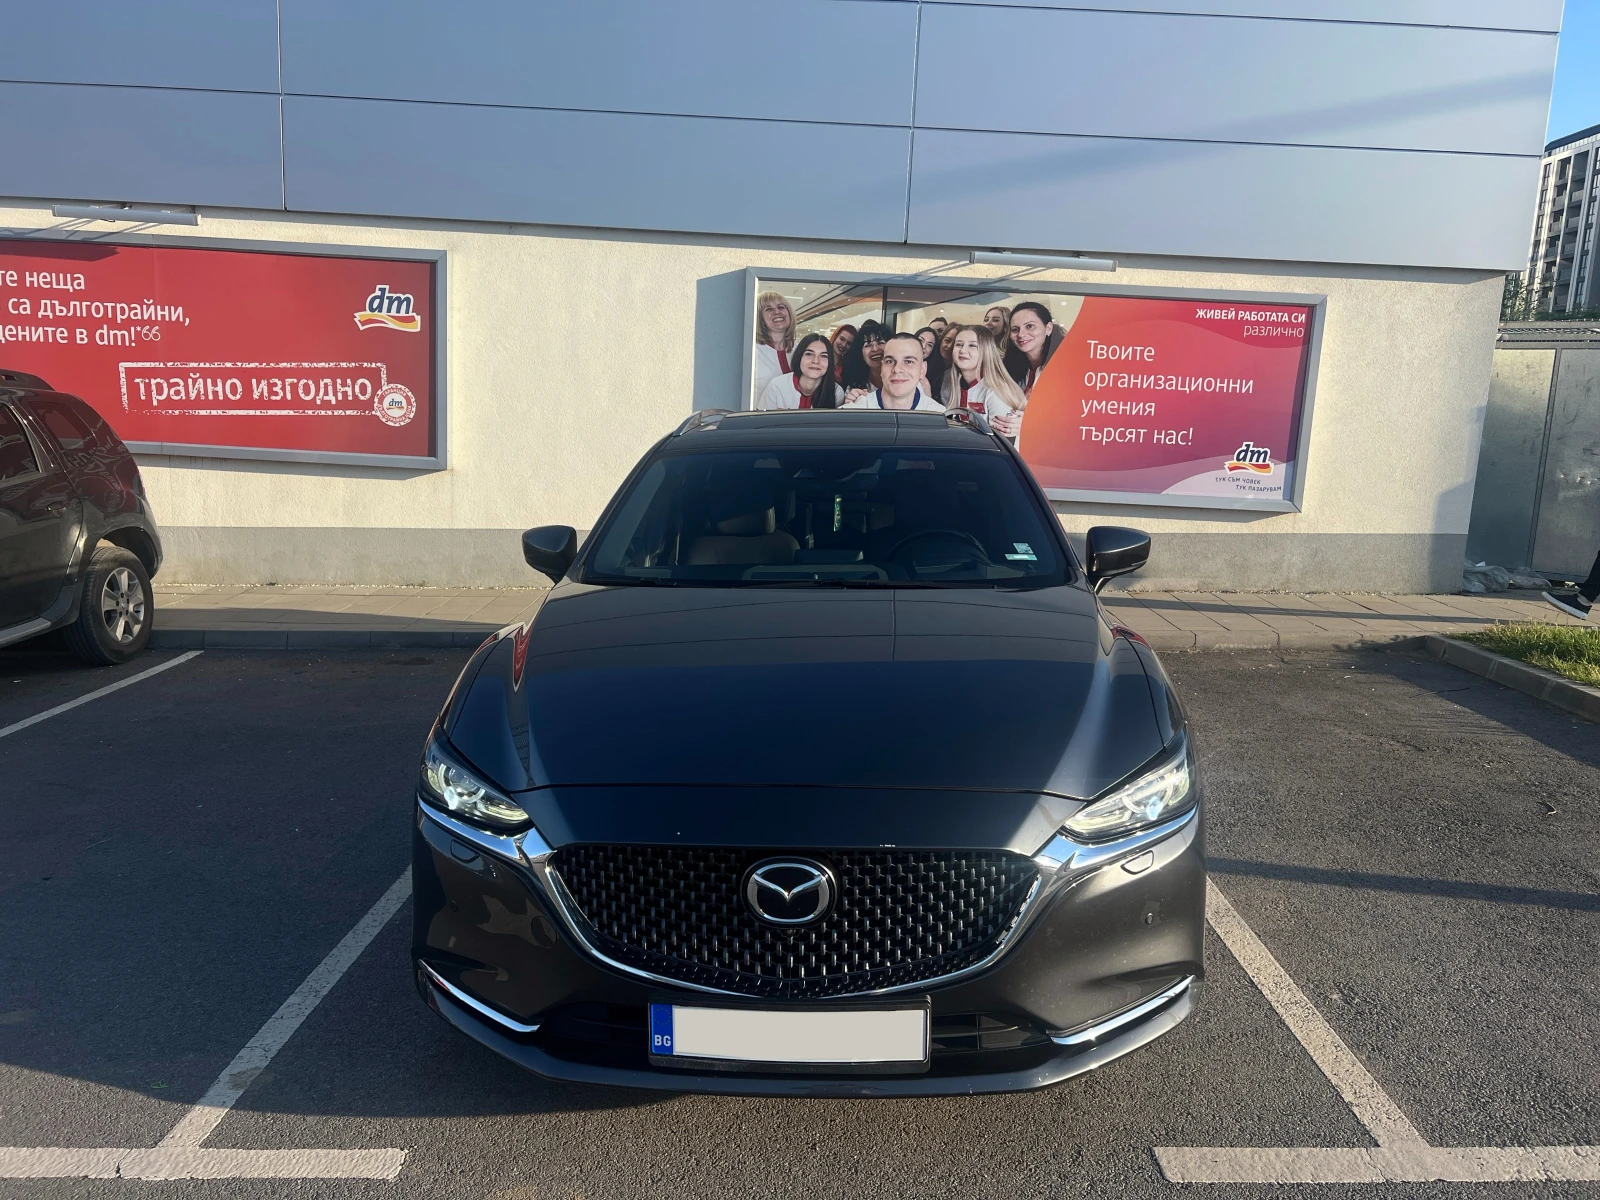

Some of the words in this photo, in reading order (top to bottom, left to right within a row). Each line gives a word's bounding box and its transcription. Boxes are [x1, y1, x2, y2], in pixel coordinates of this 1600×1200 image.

[25, 271, 85, 293] неща
[368, 287, 412, 315] dm
[8, 297, 31, 315] са
[37, 298, 190, 327] дълготрайни,
[1195, 308, 1235, 320] ЖИВЕЙ
[1238, 311, 1289, 323] РАБОТАТА
[1291, 312, 1306, 323] СИ
[75, 328, 88, 344] в
[1243, 325, 1304, 338] различно
[1087, 340, 1155, 362] Твоите
[133, 372, 243, 406] трайно
[251, 377, 372, 405] изгодно
[1084, 371, 1254, 394] организационни
[388, 398, 403, 406] dm
[1081, 399, 1156, 417] умения
[1079, 426, 1148, 445] търсят
[1153, 427, 1194, 445] нас!
[1235, 444, 1268, 463] dm
[654, 1034, 671, 1047] BG
